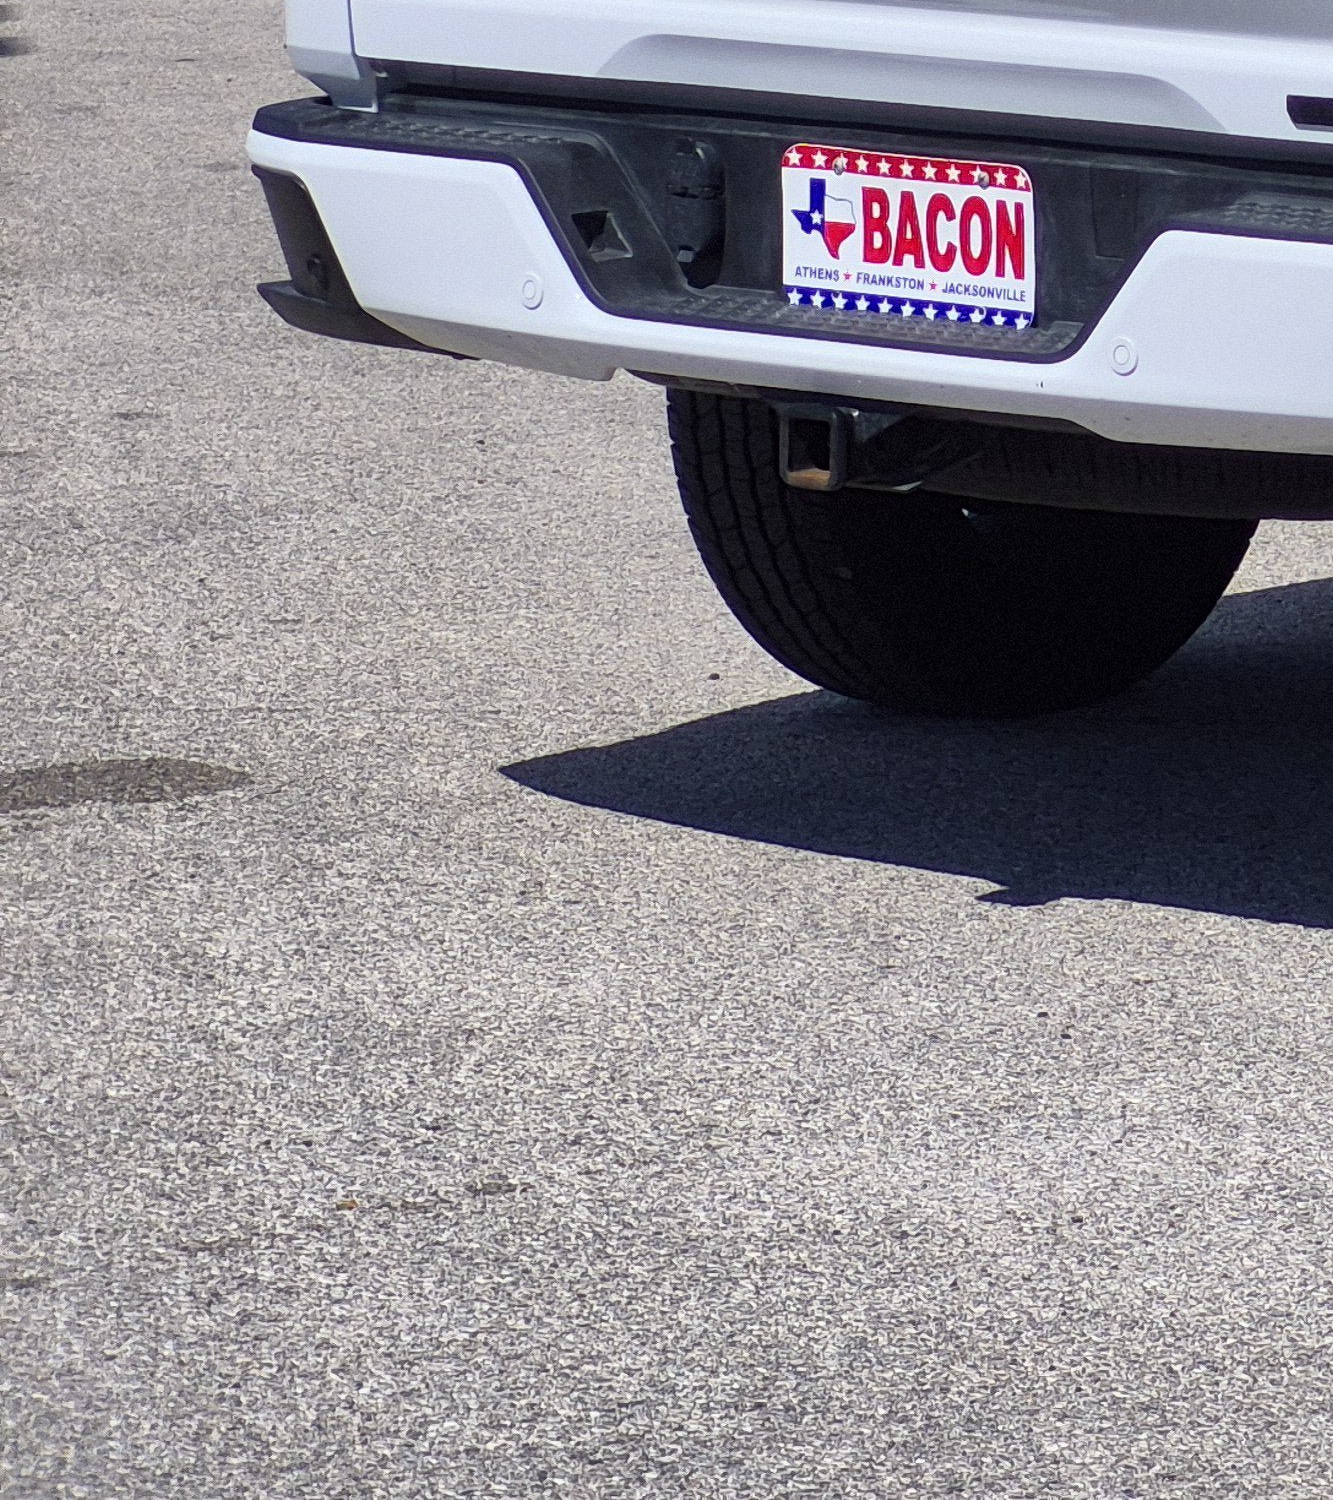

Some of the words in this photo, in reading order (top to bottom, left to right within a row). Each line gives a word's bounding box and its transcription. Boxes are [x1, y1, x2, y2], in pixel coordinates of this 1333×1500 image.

[861, 186, 1025, 280] BACON
[794, 266, 840, 283] ATHENS
[856, 271, 925, 291] FRANKSTON
[941, 282, 1026, 302] JACKSONVILLE
